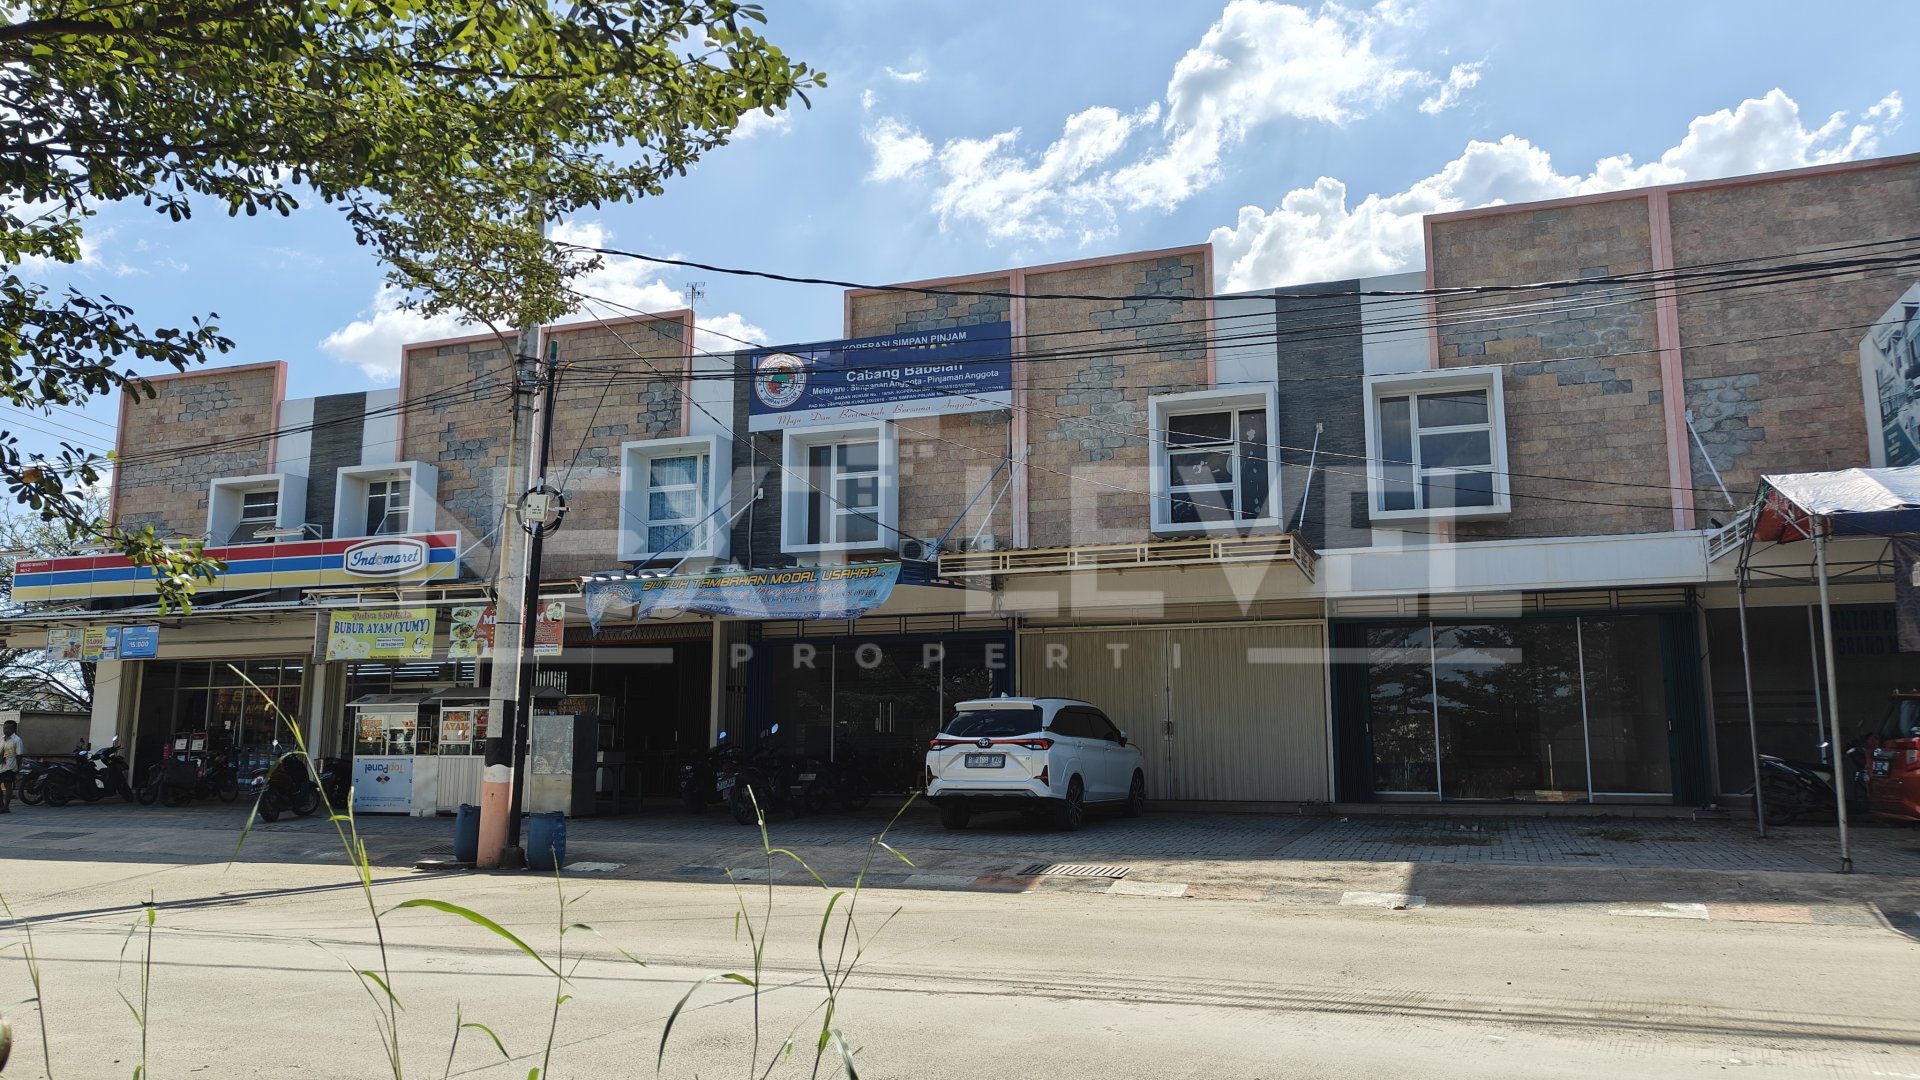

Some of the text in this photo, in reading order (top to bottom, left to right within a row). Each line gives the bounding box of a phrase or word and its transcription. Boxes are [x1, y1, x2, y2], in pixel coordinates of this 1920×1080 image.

[892, 336, 928, 347] SIMPAN
[930, 332, 967, 343] PINJAM
[846, 368, 900, 383] Cabang
[850, 382, 888, 391] Simpanan
[927, 374, 964, 384] Pinjaman
[964, 370, 999, 380] Anggota
[810, 411, 831, 421] Dan
[350, 548, 419, 567] Indomaret
[641, 579, 690, 591] BUTUH
[692, 573, 767, 588] TAMBAHAN
[769, 570, 818, 584] MODAL
[334, 618, 430, 635] BUBUR AYAM (YUMY)
[364, 762, 404, 774] TopPanel
